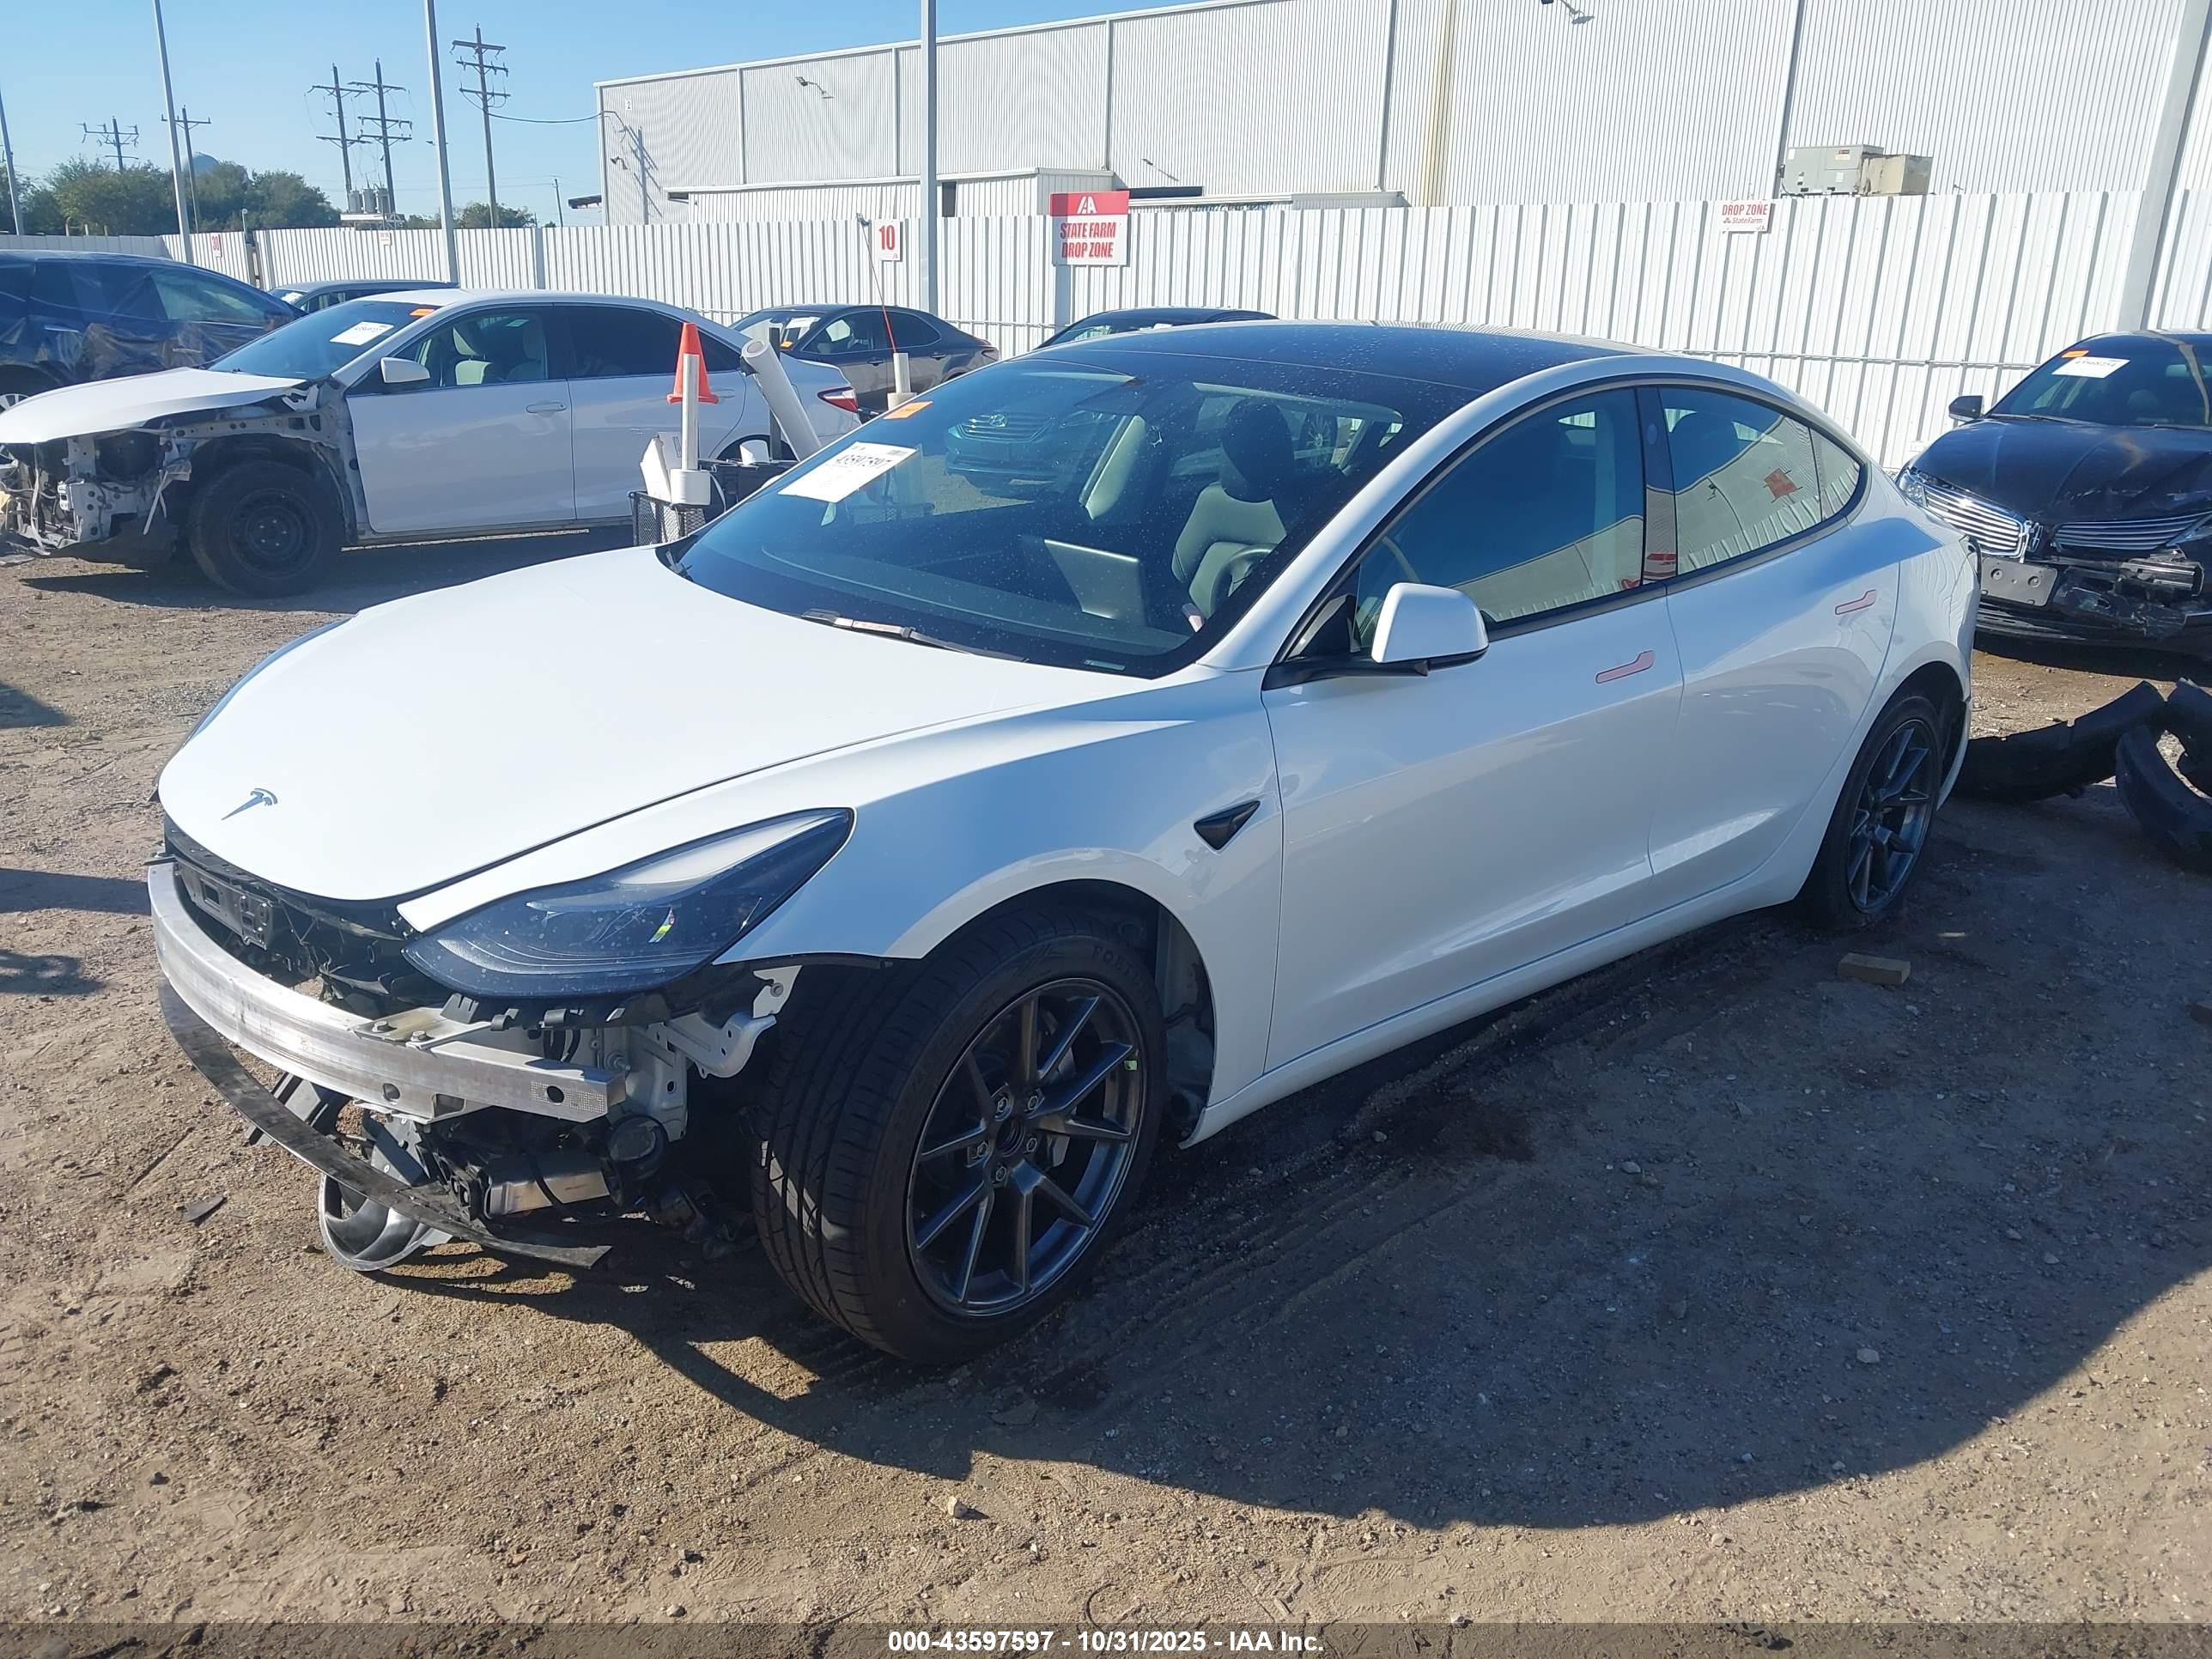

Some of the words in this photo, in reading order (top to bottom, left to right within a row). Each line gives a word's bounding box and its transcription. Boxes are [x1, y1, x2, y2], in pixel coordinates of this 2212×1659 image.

[1722, 204, 1745, 216] DROP
[1746, 204, 1768, 216] ZONE
[878, 225, 895, 250] 10
[1060, 222, 1087, 239] STATE
[1089, 222, 1117, 238] FARM
[1061, 242, 1088, 258] DROP
[1089, 242, 1114, 258] ZONE
